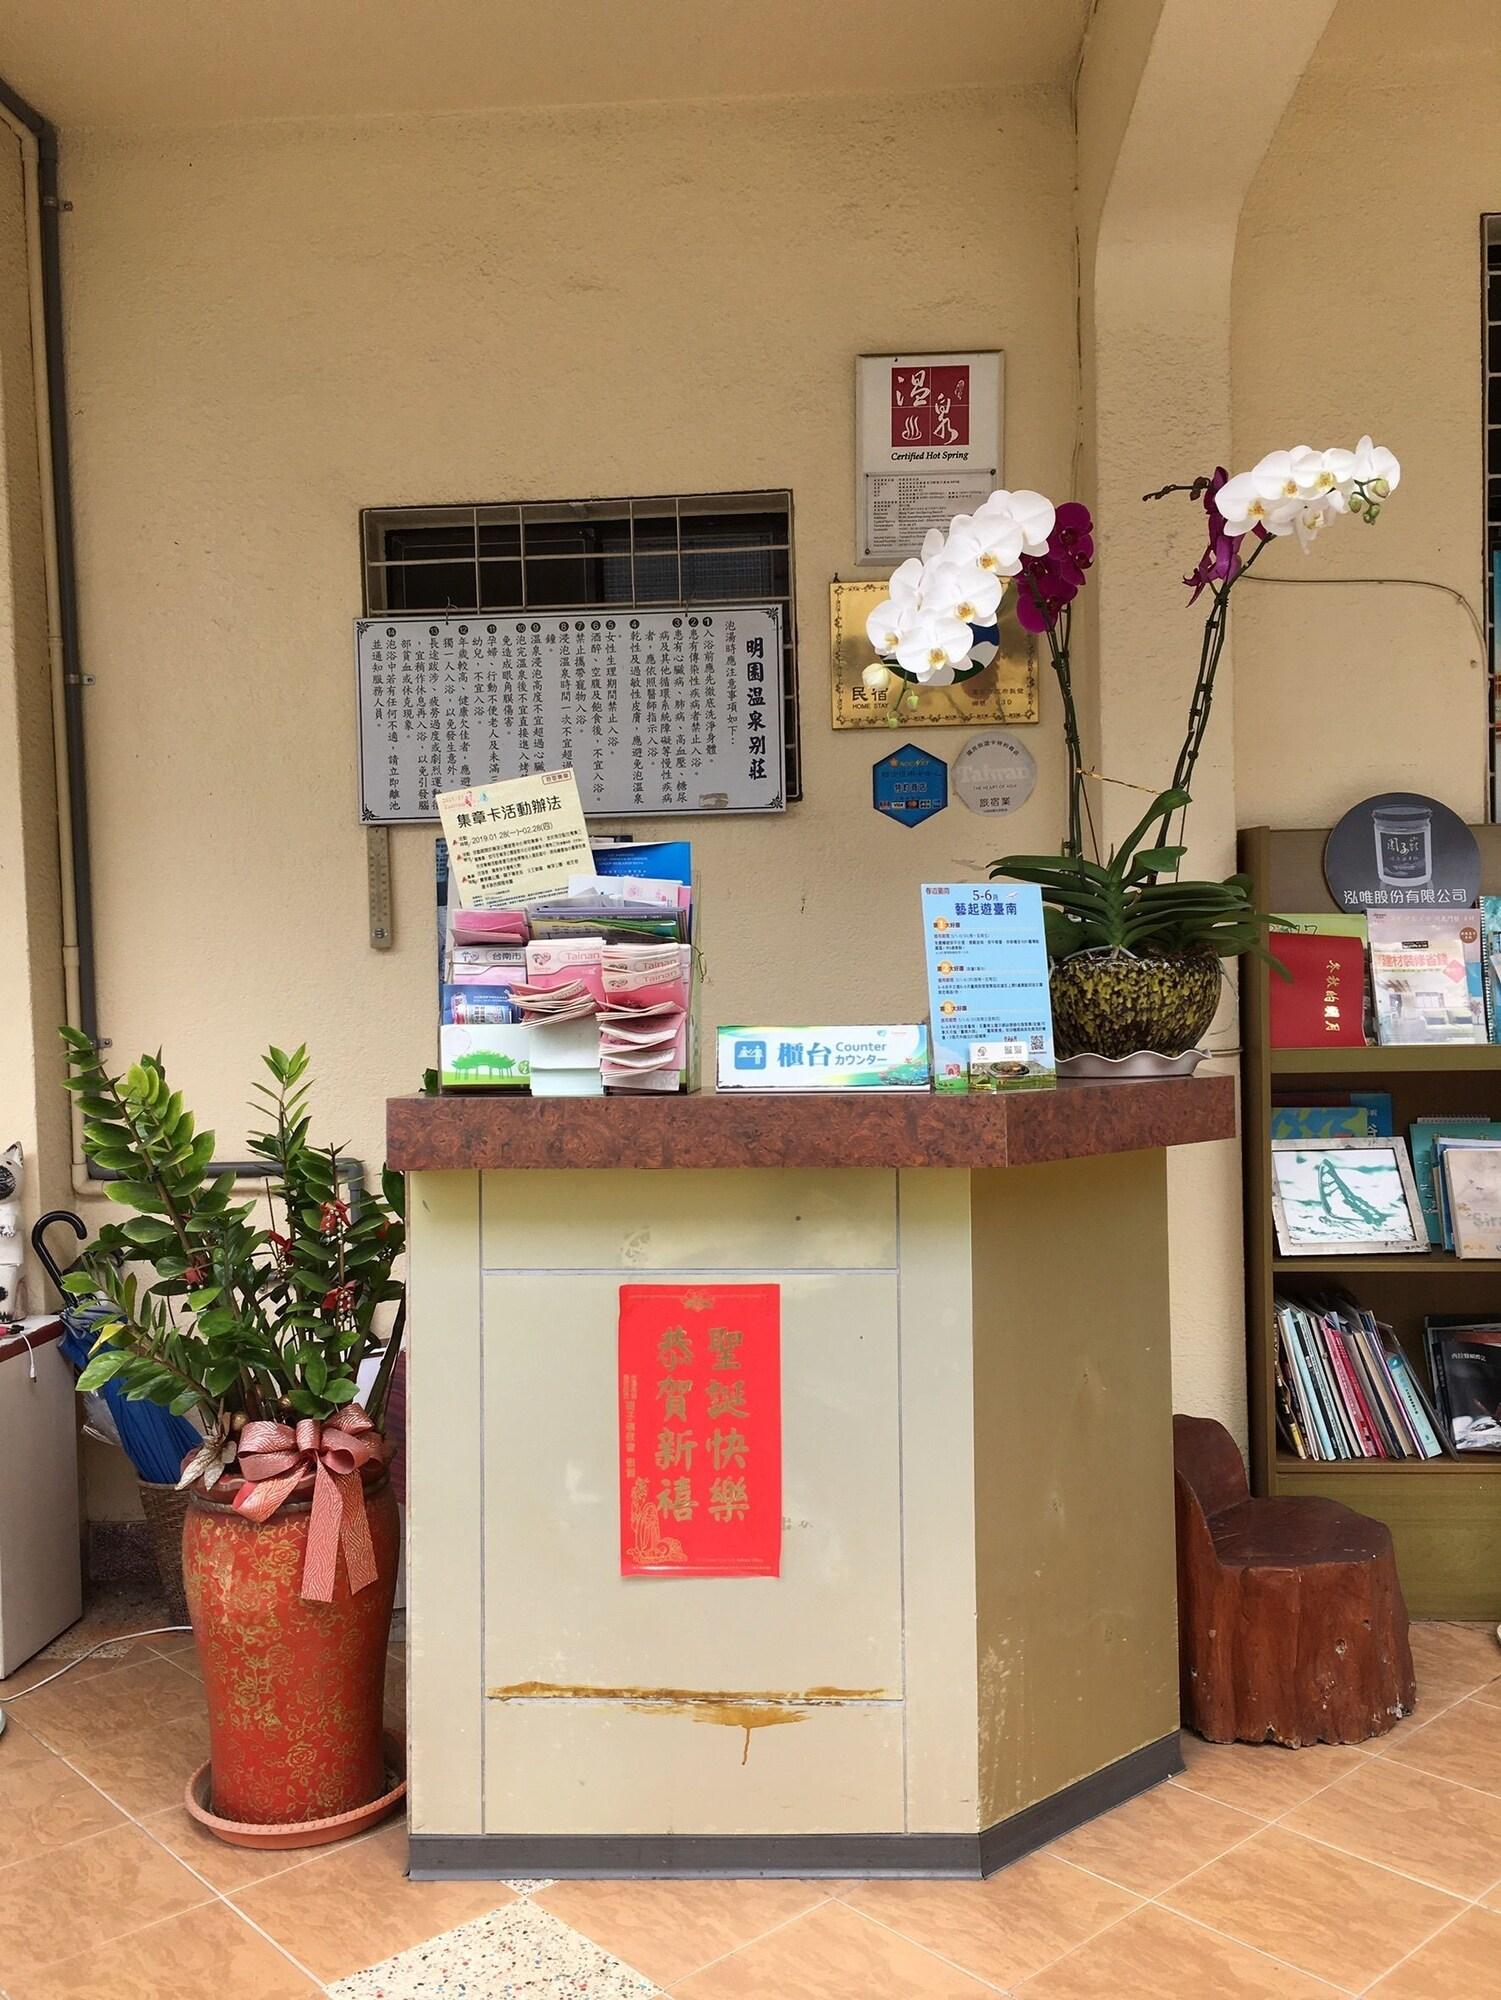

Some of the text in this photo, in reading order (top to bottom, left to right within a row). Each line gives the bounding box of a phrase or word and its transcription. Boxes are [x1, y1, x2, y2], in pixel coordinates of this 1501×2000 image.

[891, 451, 969, 462] Certified Hot Spring
[852, 686, 889, 702] 民宿
[959, 763, 1031, 783] Taiwan
[457, 795, 562, 829] 集章卡活動辦法
[1344, 888, 1467, 904] 泓唯股份有限公司
[955, 903, 1017, 915] 藝起遊臺南
[492, 950, 522, 961] 台南市
[566, 951, 600, 961] Tainan
[643, 958, 678, 971] Tainan
[643, 970, 678, 983] Tainan
[836, 1042, 887, 1052] Counter
[777, 1042, 831, 1067] 櫃台
[835, 1054, 888, 1066] カウンター
[654, 1324, 699, 1523] 恭賀新禧
[704, 1326, 751, 1524] 聖誕快樂
